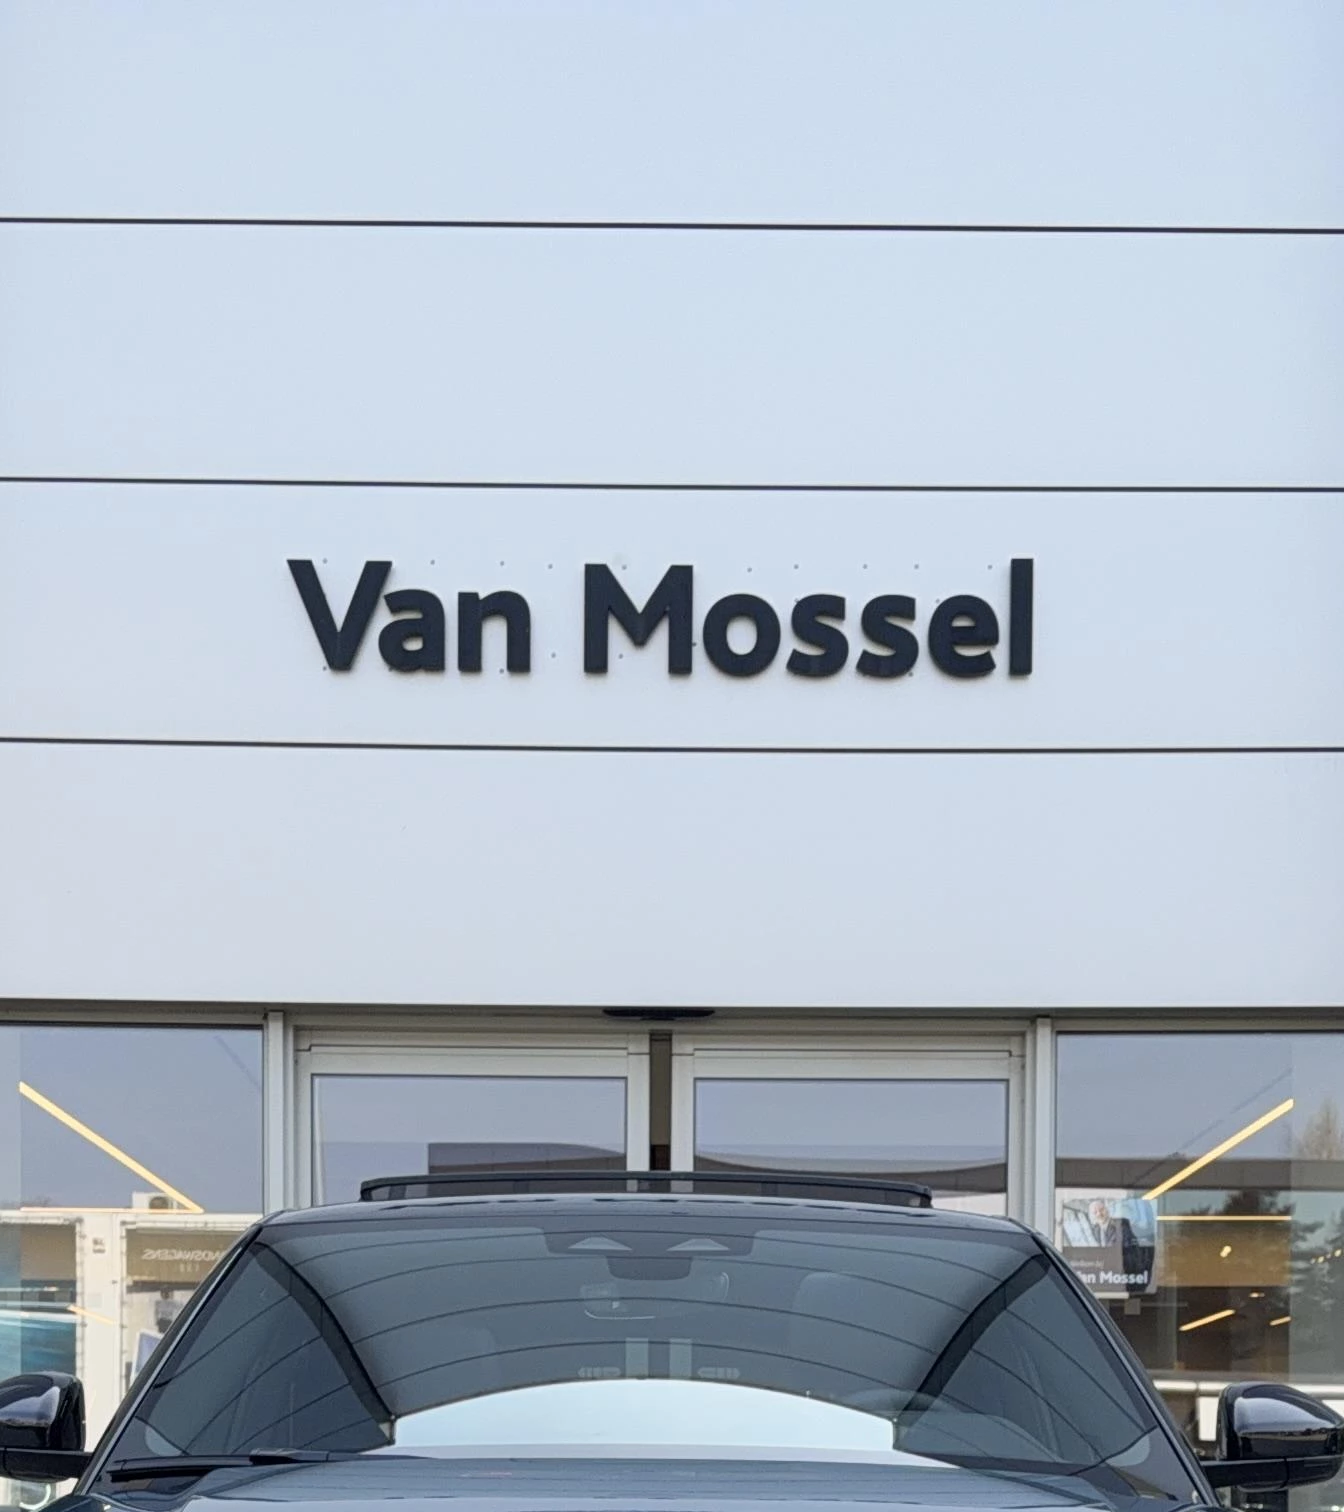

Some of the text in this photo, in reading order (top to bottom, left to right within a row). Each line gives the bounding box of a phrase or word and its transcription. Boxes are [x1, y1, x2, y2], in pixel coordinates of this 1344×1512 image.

[286, 557, 1035, 679] Van Mossel
[1099, 1269, 1149, 1285] Mossel
